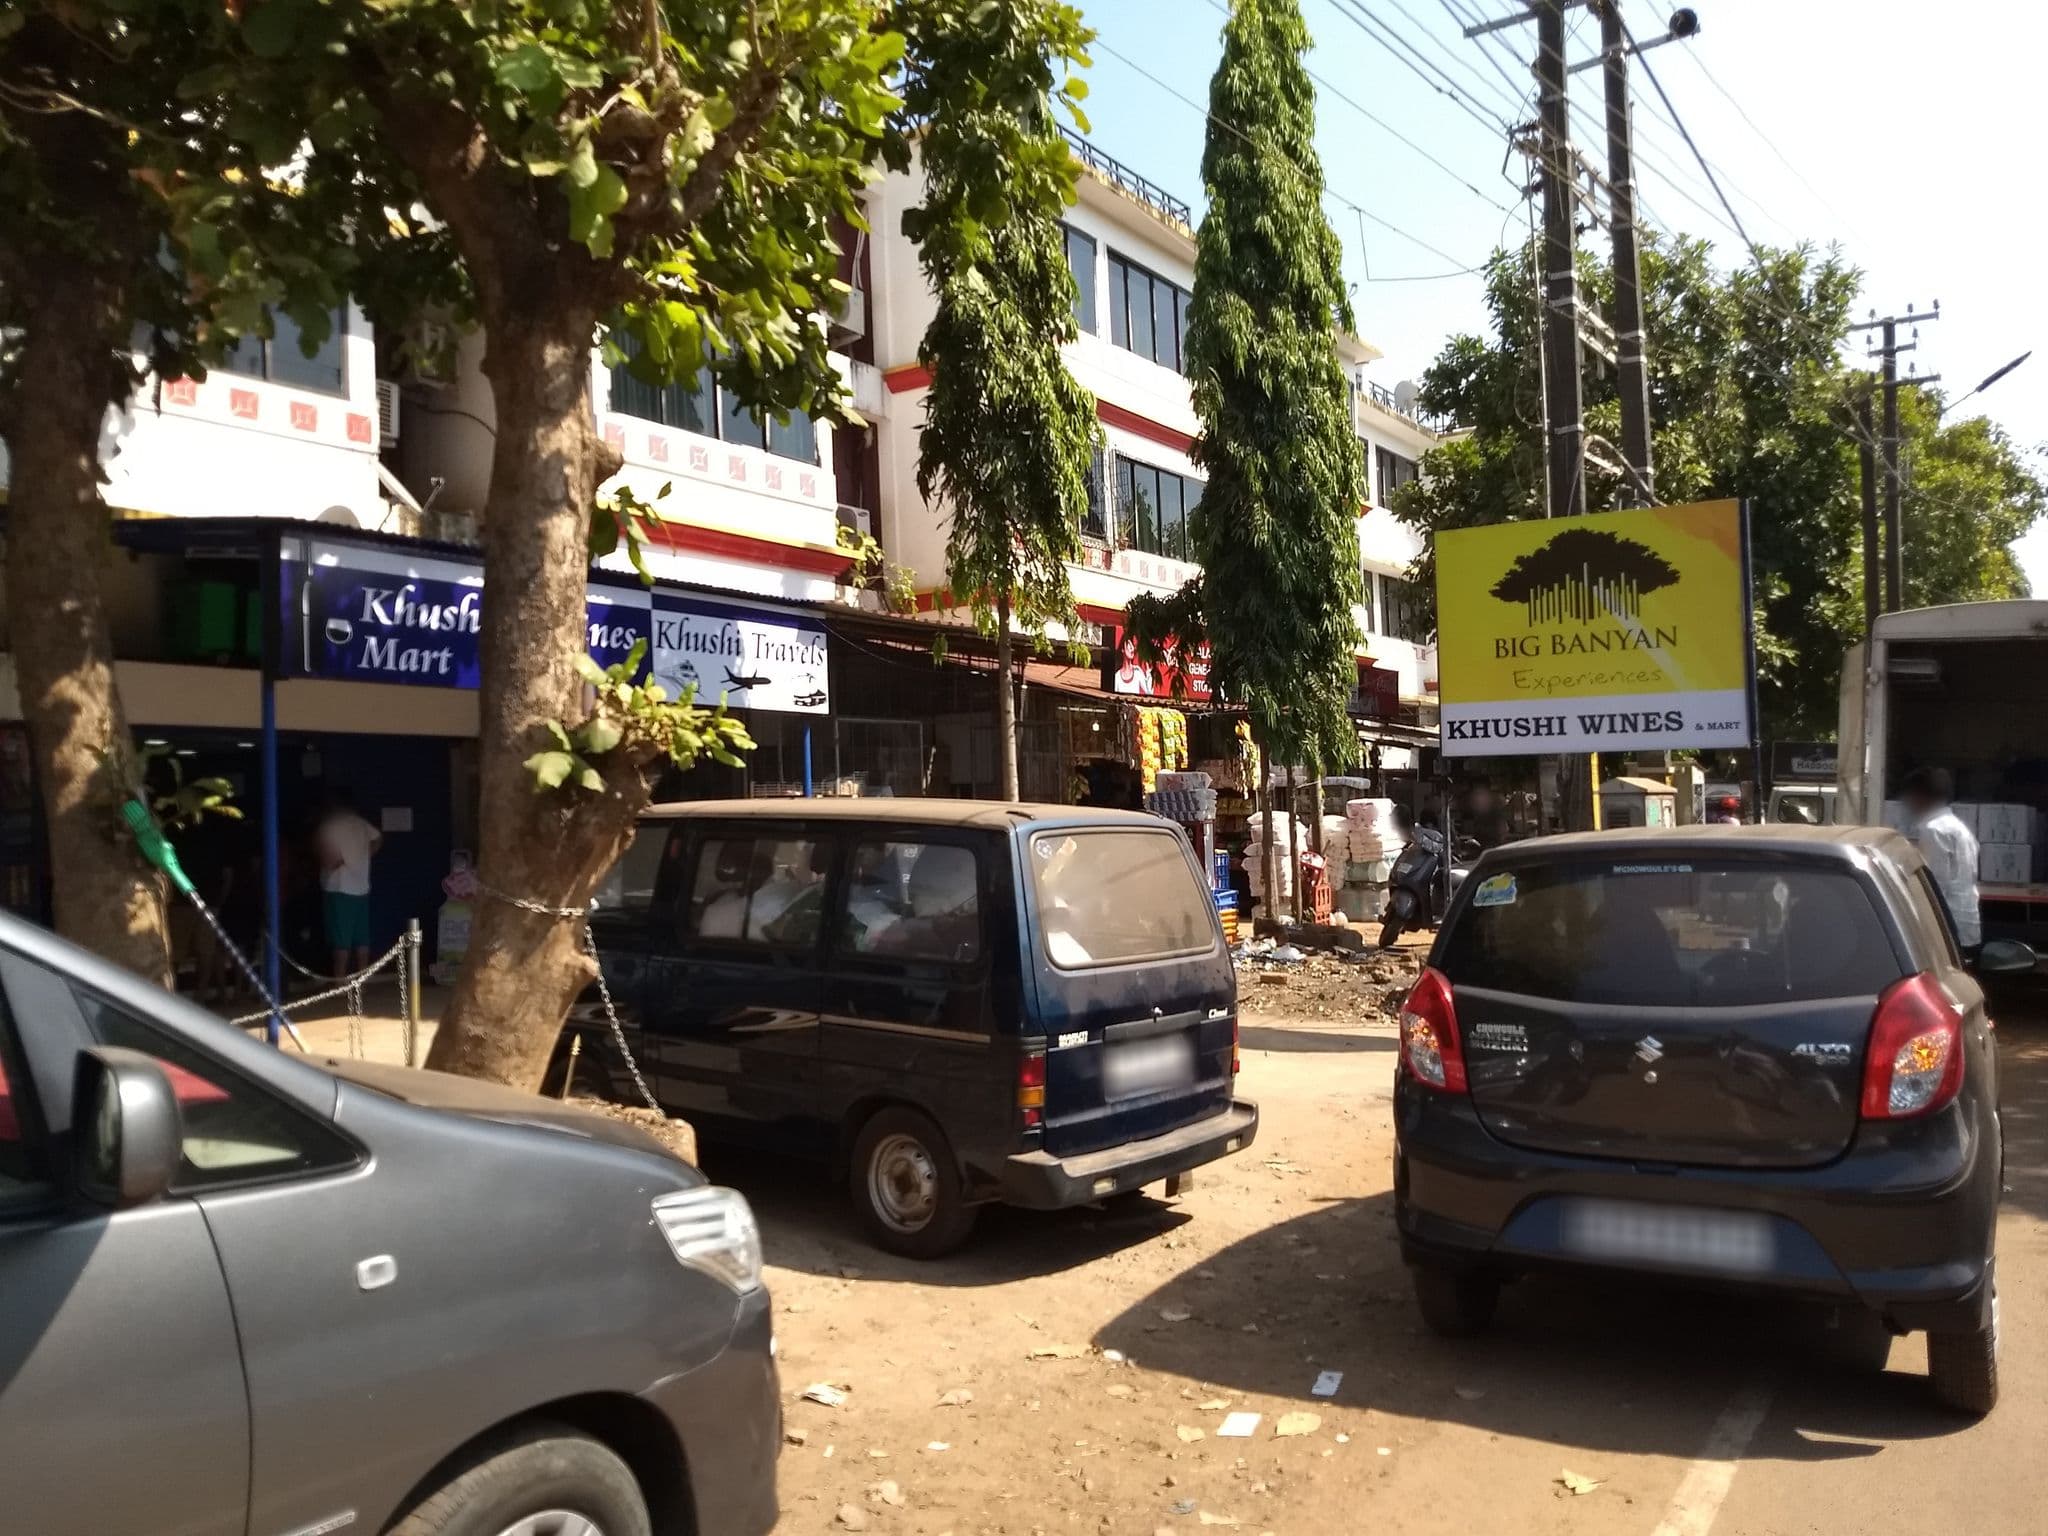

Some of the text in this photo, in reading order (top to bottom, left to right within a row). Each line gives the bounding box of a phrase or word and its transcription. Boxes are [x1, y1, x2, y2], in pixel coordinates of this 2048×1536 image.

[359, 584, 481, 633] Khush
[586, 622, 637, 651] nes
[655, 616, 824, 666] Khushi Travels
[1495, 625, 1678, 659] BIG BANYAN
[357, 635, 454, 675] Mart
[1512, 668, 1663, 695] Experiences
[1447, 710, 1741, 740] KHUSHI WINES & MART
